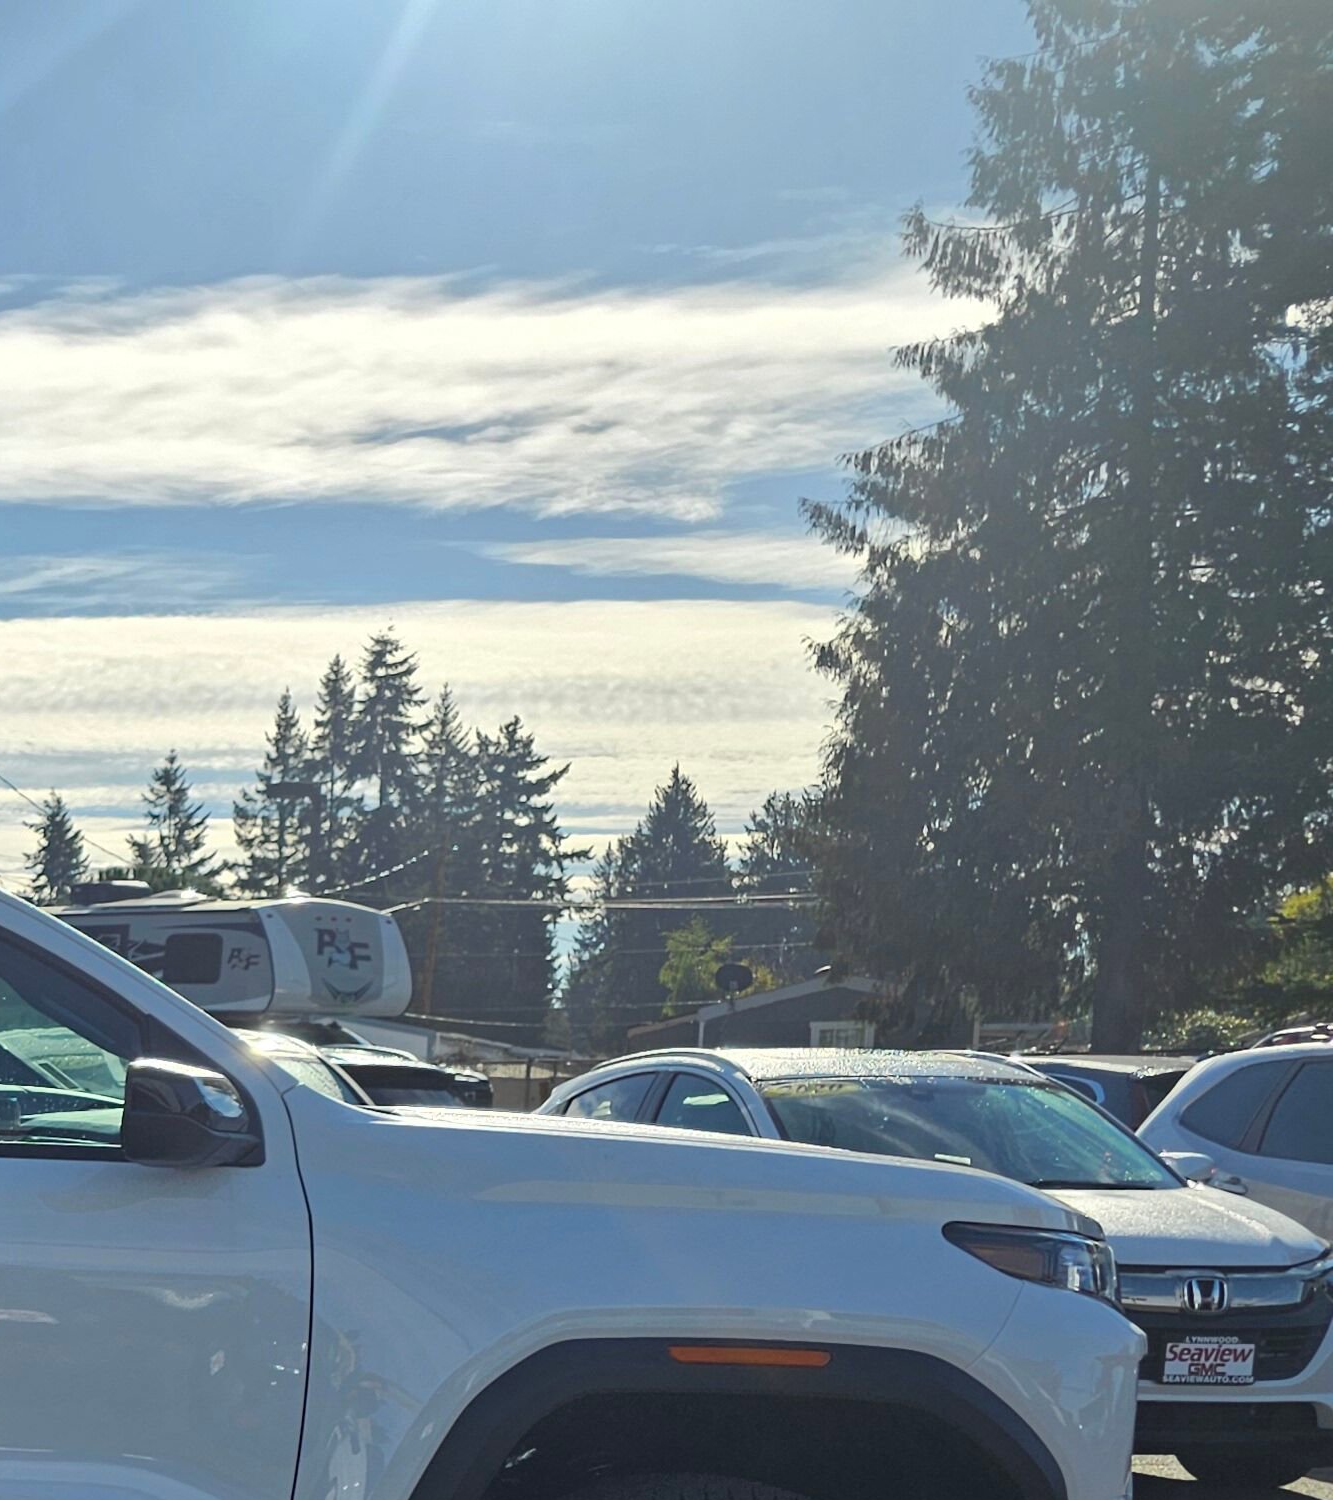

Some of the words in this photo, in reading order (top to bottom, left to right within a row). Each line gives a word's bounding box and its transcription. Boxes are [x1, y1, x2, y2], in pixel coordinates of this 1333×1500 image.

[1185, 1335, 1239, 1344] LYNNWOOD
[1165, 1344, 1253, 1362] Seaview
[1188, 1363, 1226, 1376] GMC
[1162, 1375, 1255, 1384] SEAVIEWAUTO.COM
